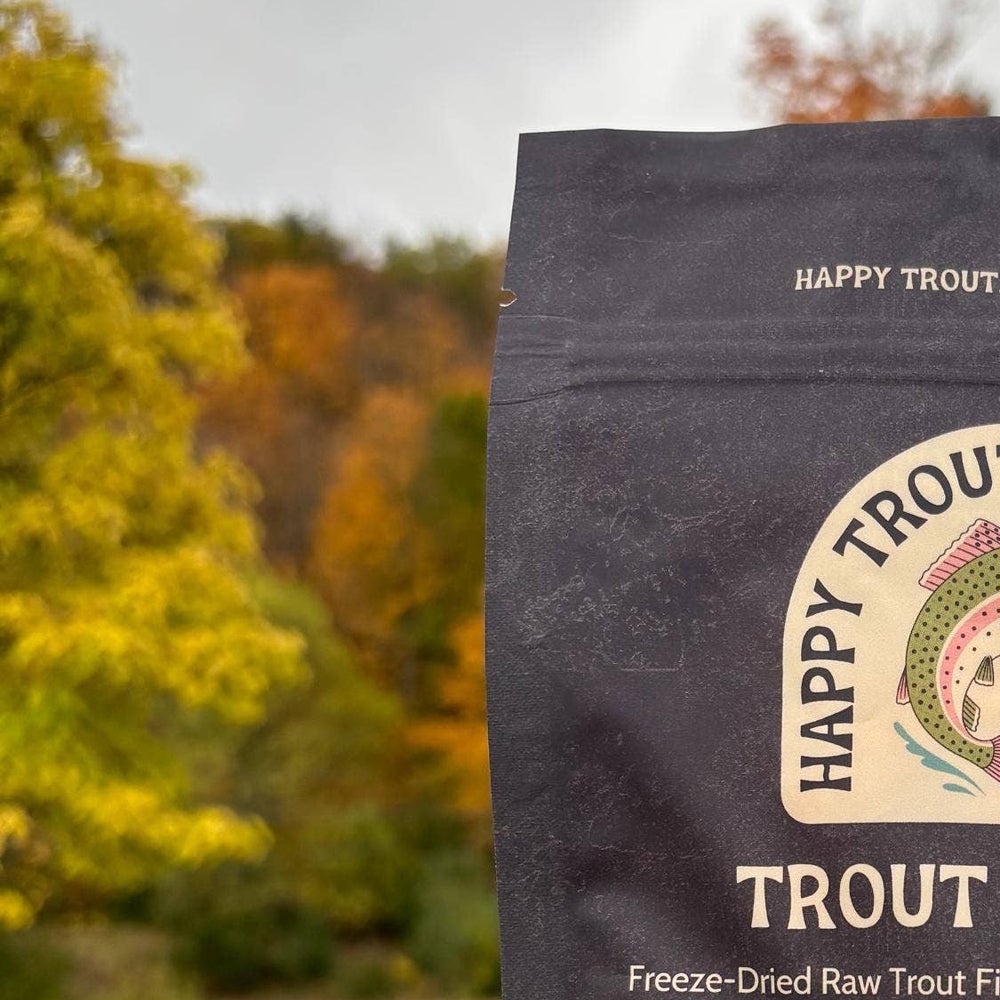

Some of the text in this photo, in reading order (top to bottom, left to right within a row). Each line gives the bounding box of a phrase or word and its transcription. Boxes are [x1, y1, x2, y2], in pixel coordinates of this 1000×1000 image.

[794, 265, 891, 290] HAPPY
[800, 578, 862, 792] HAPPY
[736, 864, 988, 930] TROUT
[628, 965, 811, 996] Freeze-Dried
[821, 968, 881, 996] Raw
[889, 969, 966, 997] Trout
